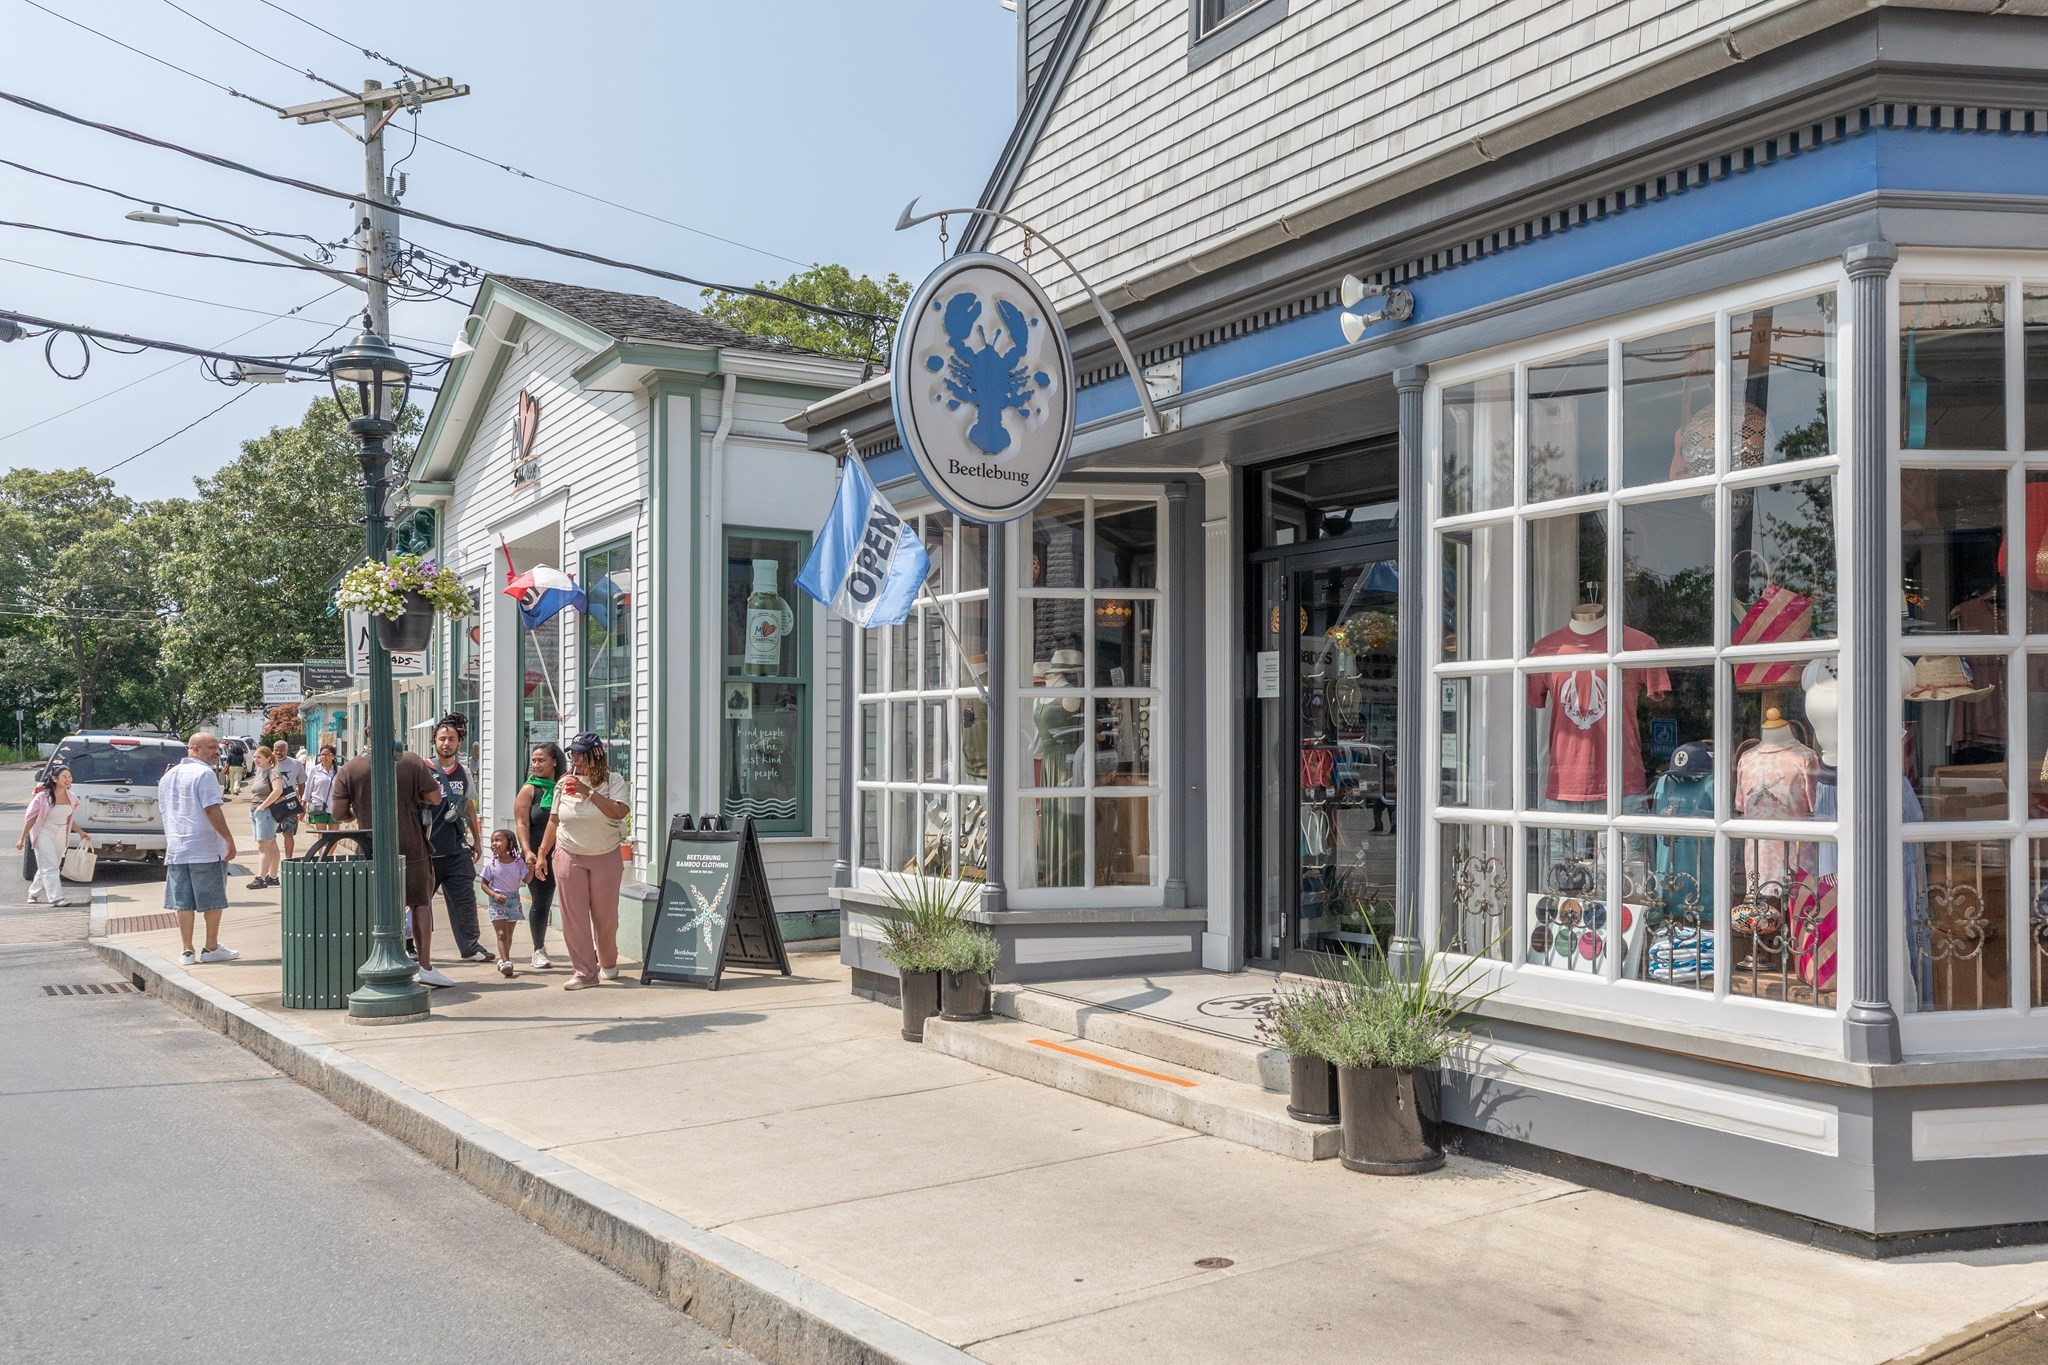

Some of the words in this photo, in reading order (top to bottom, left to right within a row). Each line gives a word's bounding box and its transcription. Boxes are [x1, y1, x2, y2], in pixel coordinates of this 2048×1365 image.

[948, 459, 1030, 486] Beetlebung
[846, 504, 901, 603] OPEN
[737, 726, 757, 738] Kind
[759, 727, 785, 740] people
[744, 742, 760, 750] are
[761, 740, 778, 752] the
[742, 754, 759, 765] best
[761, 754, 782, 765] kind
[743, 768, 751, 779] of
[754, 768, 780, 781] people
[674, 948, 698, 957] Beetlebung
